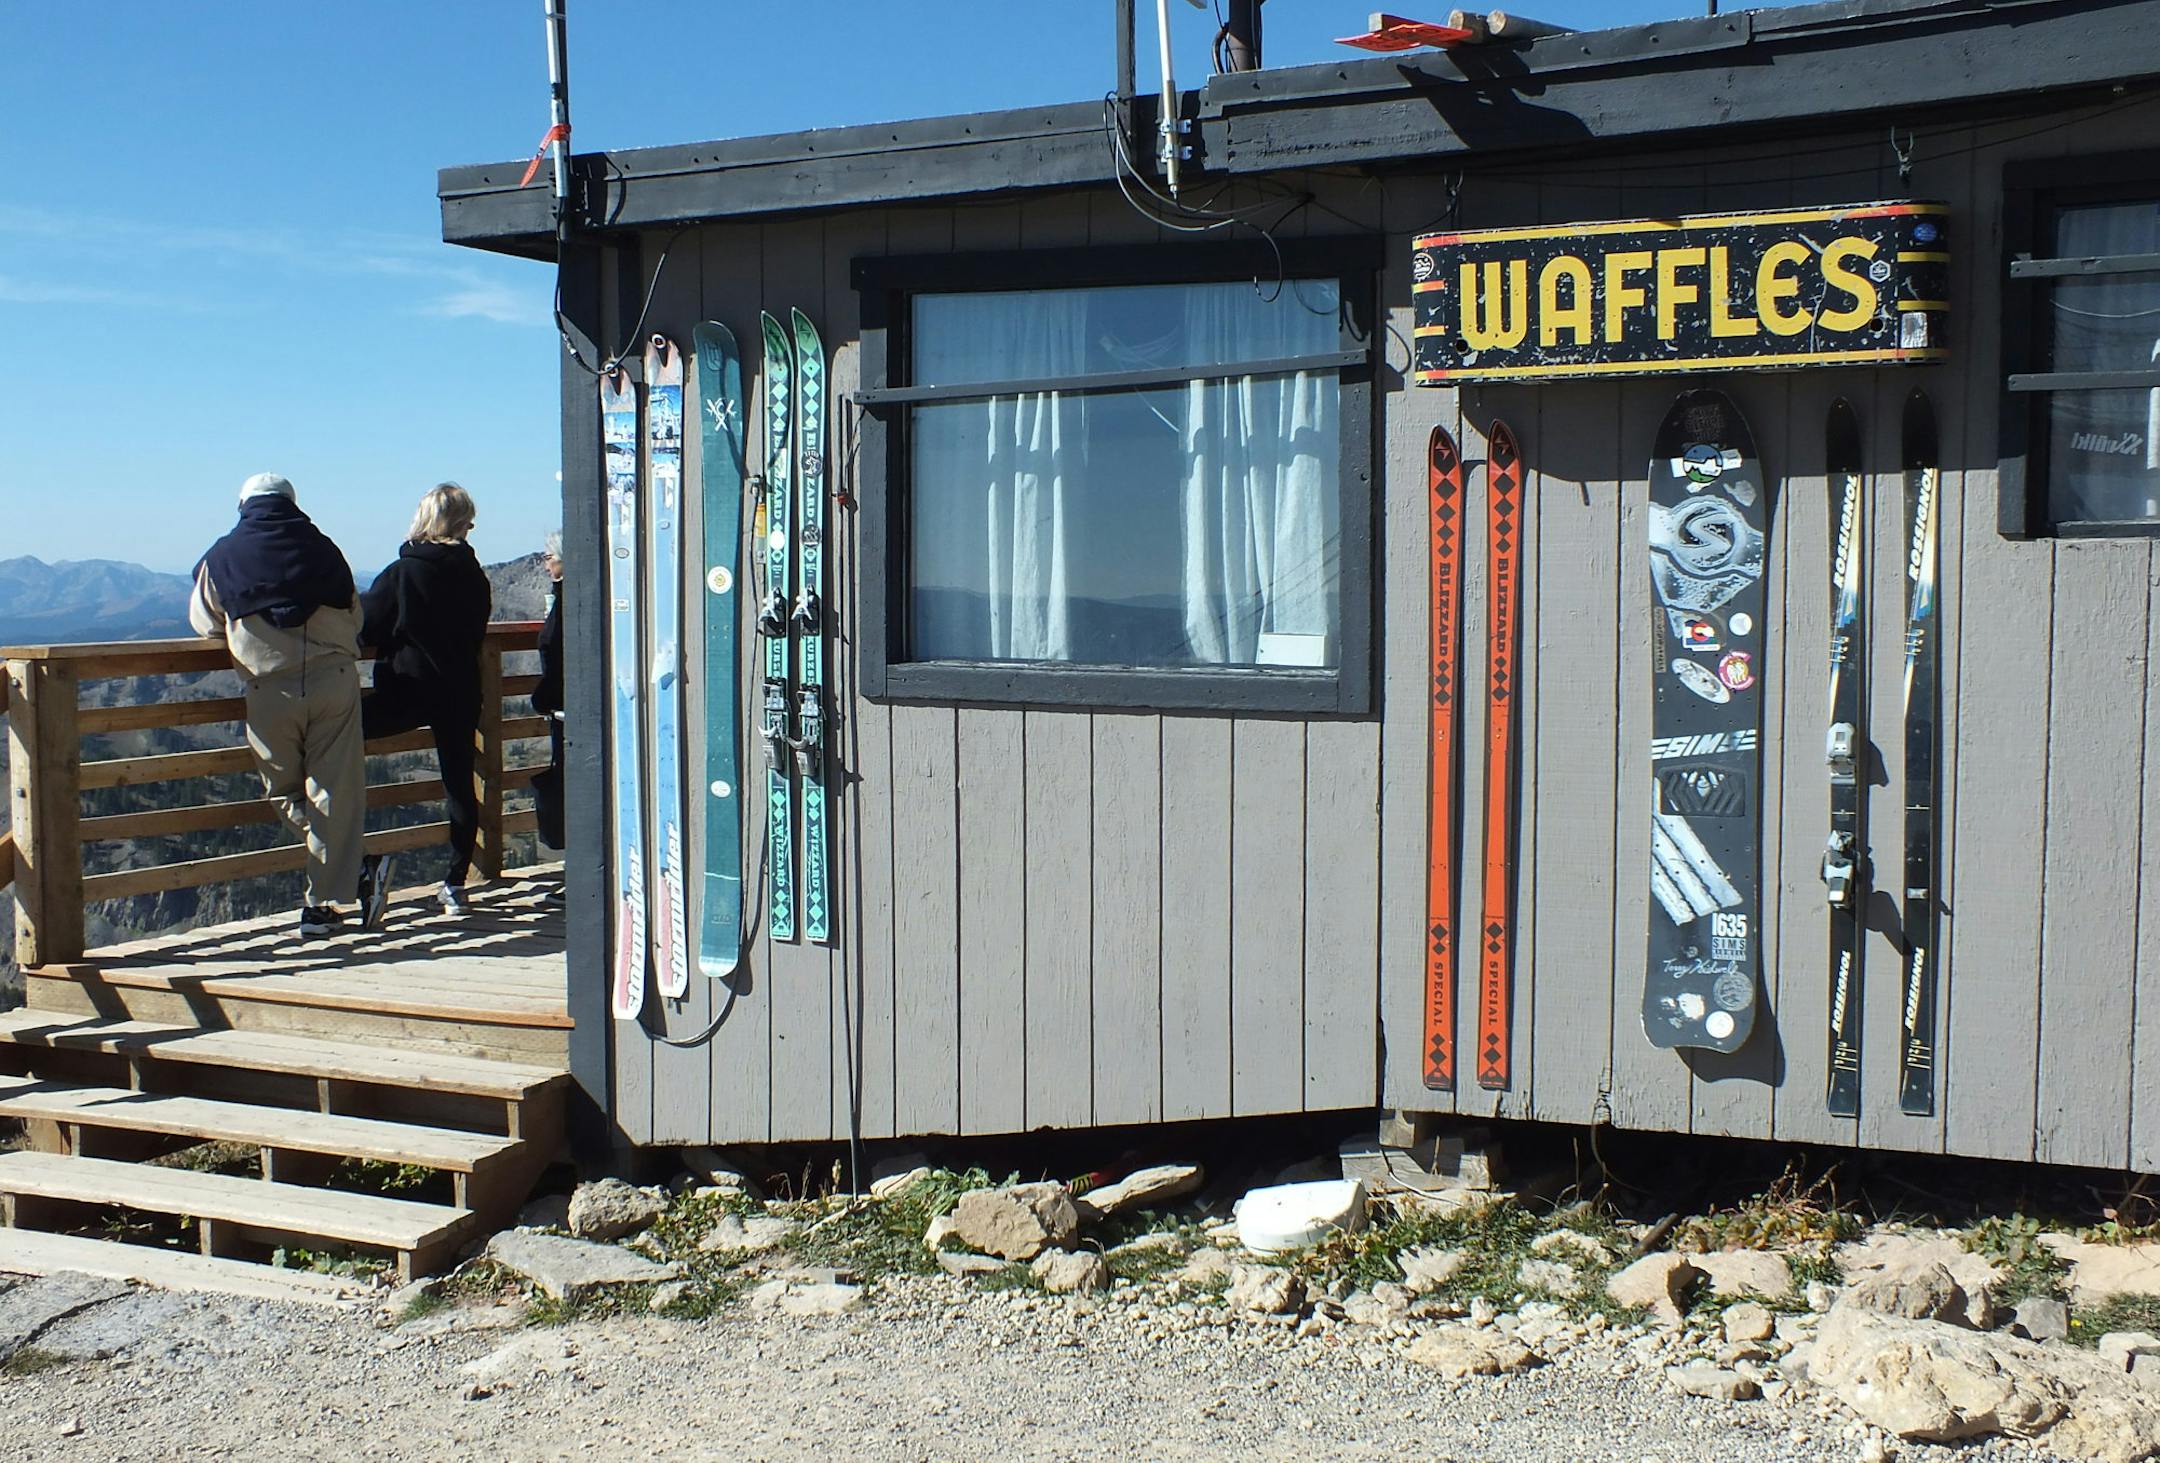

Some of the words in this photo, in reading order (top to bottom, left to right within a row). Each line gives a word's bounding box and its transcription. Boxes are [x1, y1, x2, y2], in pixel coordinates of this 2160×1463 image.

[1459, 236, 1881, 351] WAFFLES
[1833, 475, 1857, 588] ROSSIGNOL
[1908, 467, 1933, 581] ROSSIGNOL
[1438, 562, 1450, 657] BLIZZARD
[1497, 557, 1509, 653] BLIZZARD
[1661, 730, 1747, 760] SIMS
[775, 823, 784, 887] WIZZARD
[811, 824, 820, 888] WIZZARD
[1711, 912, 1748, 938] 1635
[1712, 938, 1746, 950] SIMS
[1433, 962, 1444, 1026] SPECIAL
[1488, 961, 1499, 1025] SPECIAL
[1832, 950, 1851, 1033] ROSSIGNOL
[1905, 946, 1925, 1030] ROSSIGNOL
